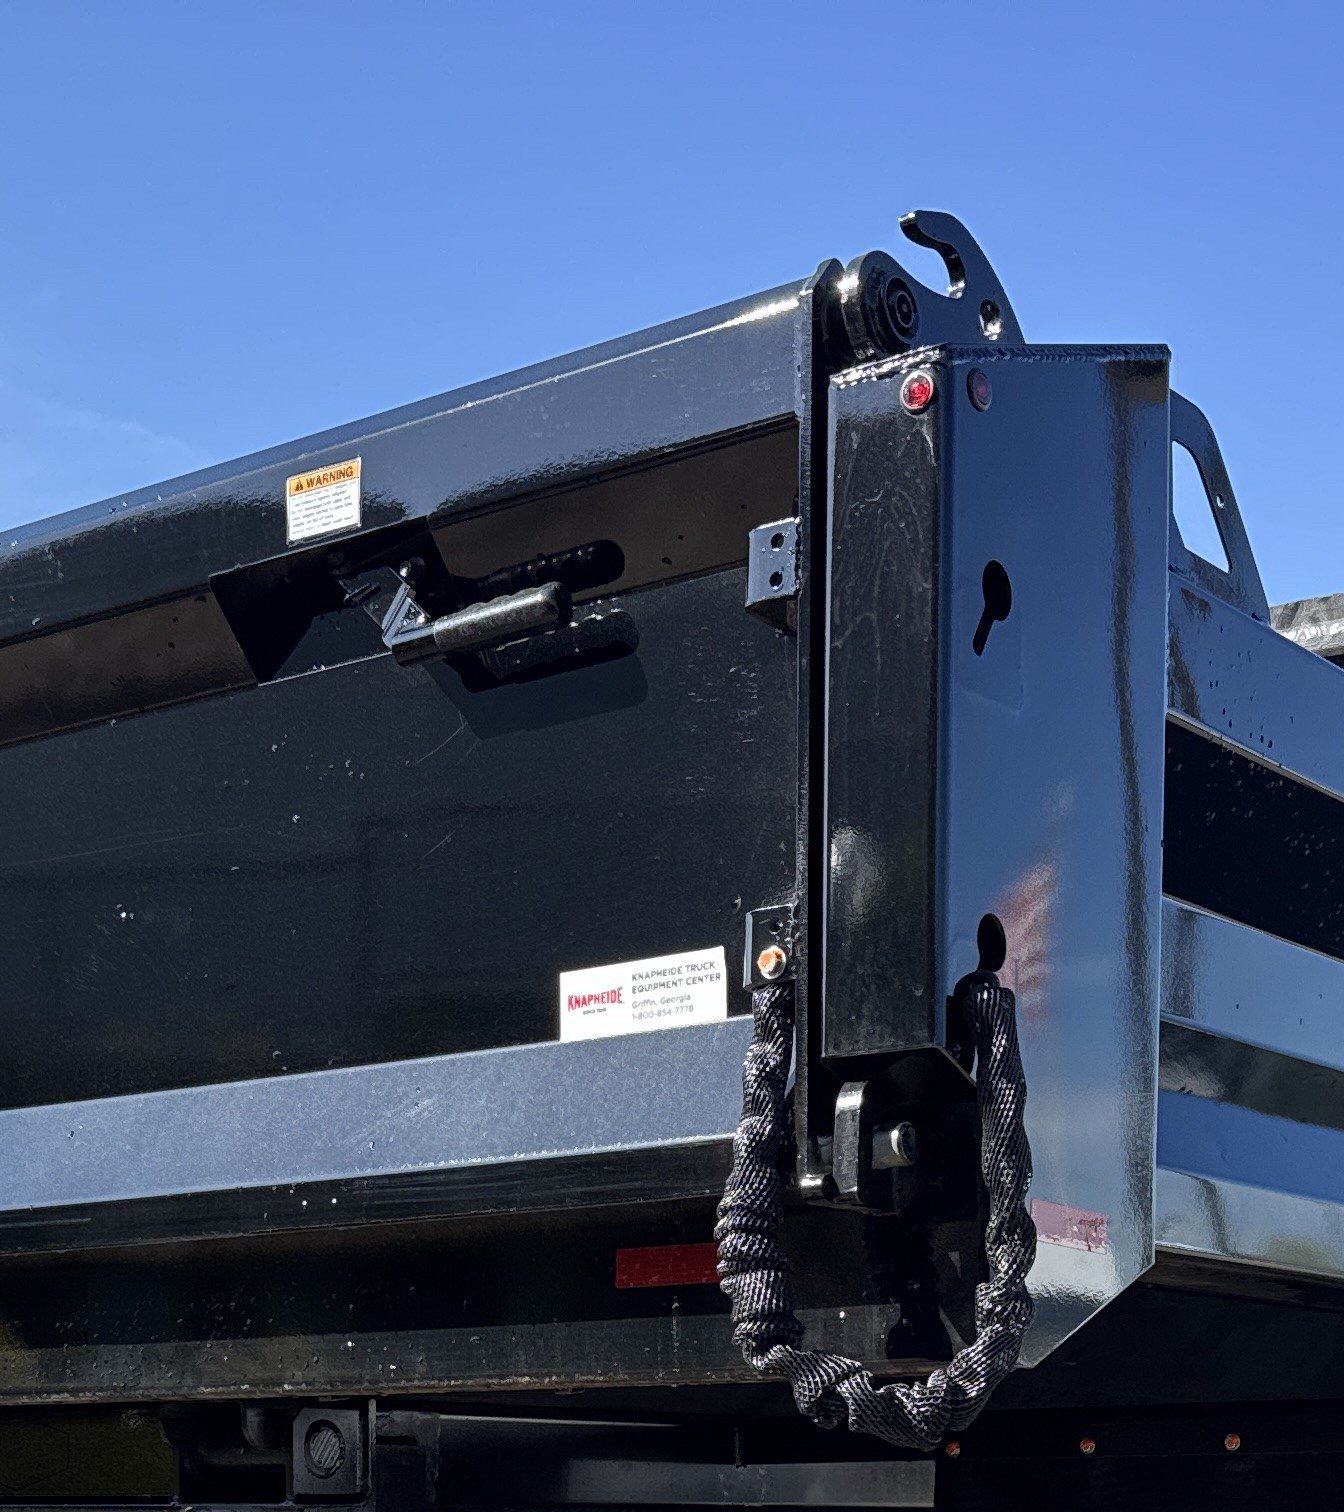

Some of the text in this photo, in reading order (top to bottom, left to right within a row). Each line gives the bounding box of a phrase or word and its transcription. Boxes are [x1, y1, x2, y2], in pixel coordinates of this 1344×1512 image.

[306, 466, 354, 488] WARNING
[631, 961, 715, 981] KNAPHEIDE TRUCK
[631, 973, 721, 994] EQUIPMENT CENTER
[567, 986, 623, 1012] KNAPHEIDE
[660, 994, 691, 1004] Georgia
